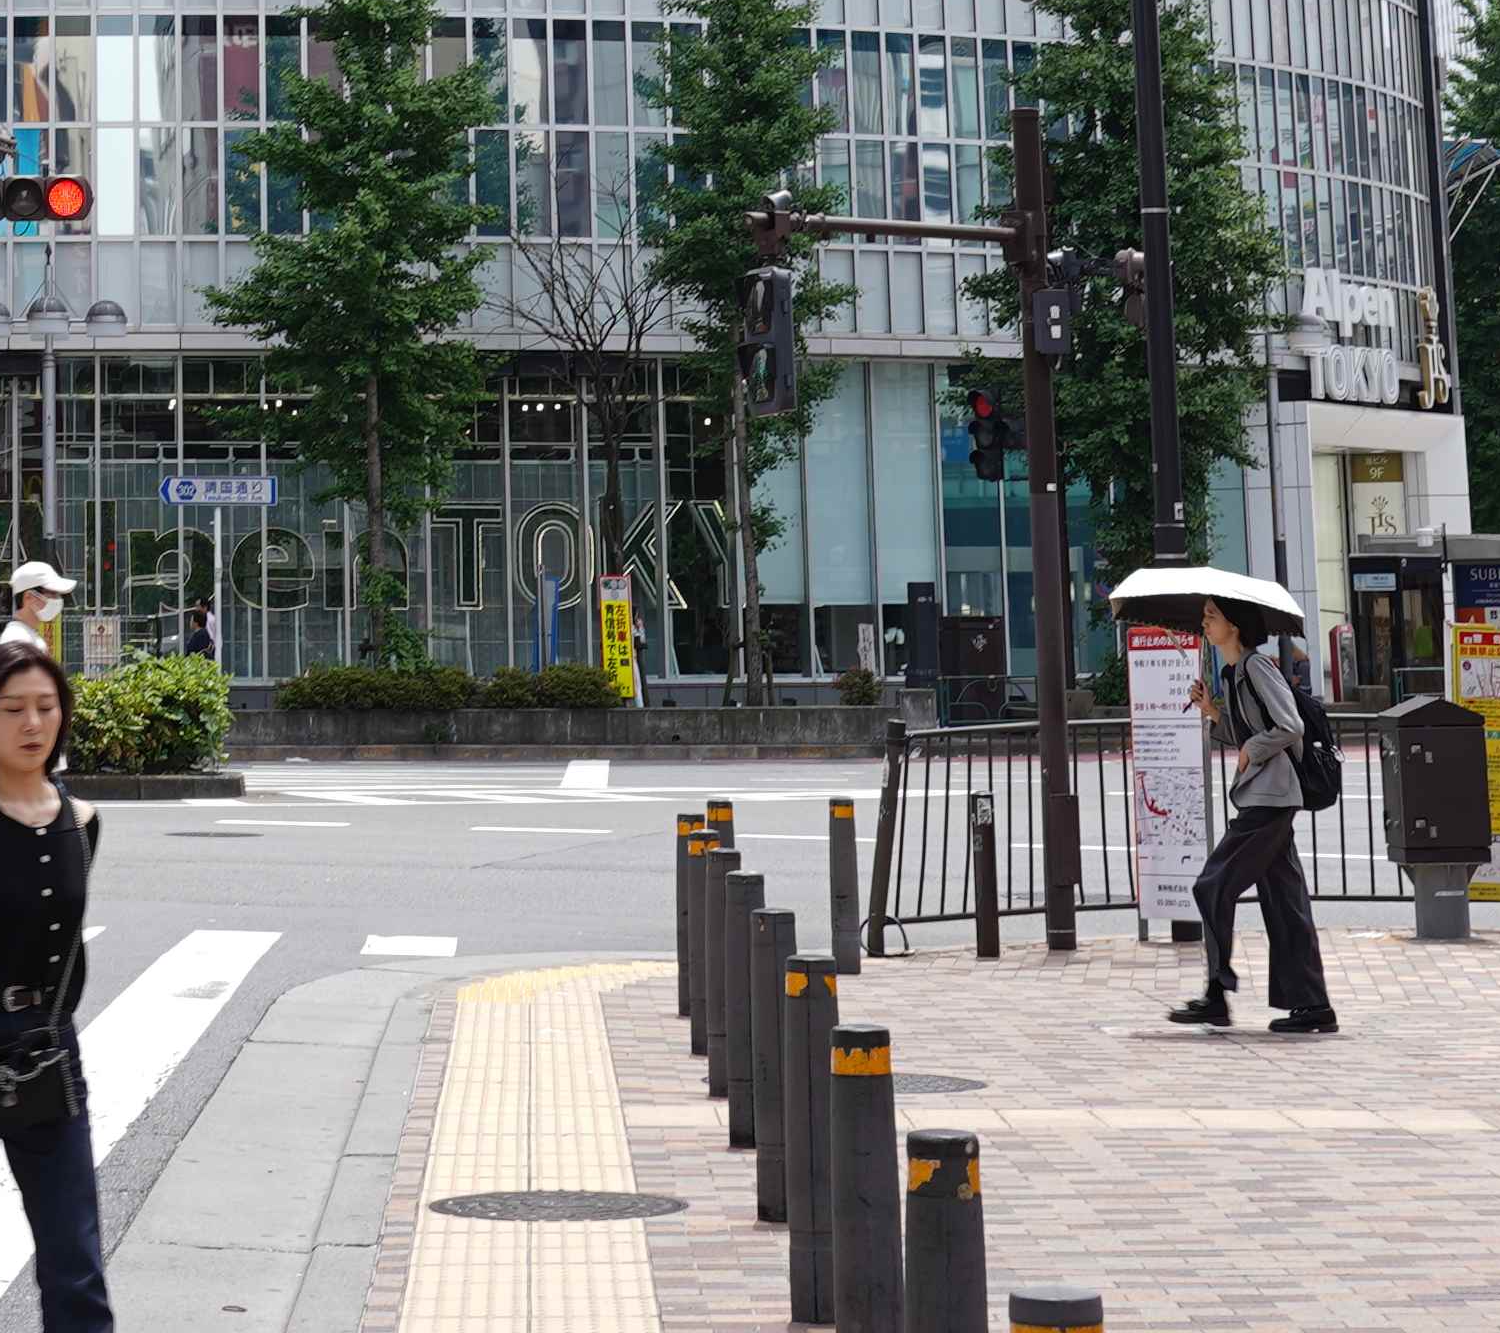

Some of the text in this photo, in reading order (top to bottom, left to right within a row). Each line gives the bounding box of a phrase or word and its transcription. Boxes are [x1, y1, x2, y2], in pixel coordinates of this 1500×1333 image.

[1300, 266, 1396, 338] Alpen
[1308, 343, 1402, 406] TOKYO
[1367, 465, 1385, 480] 9F
